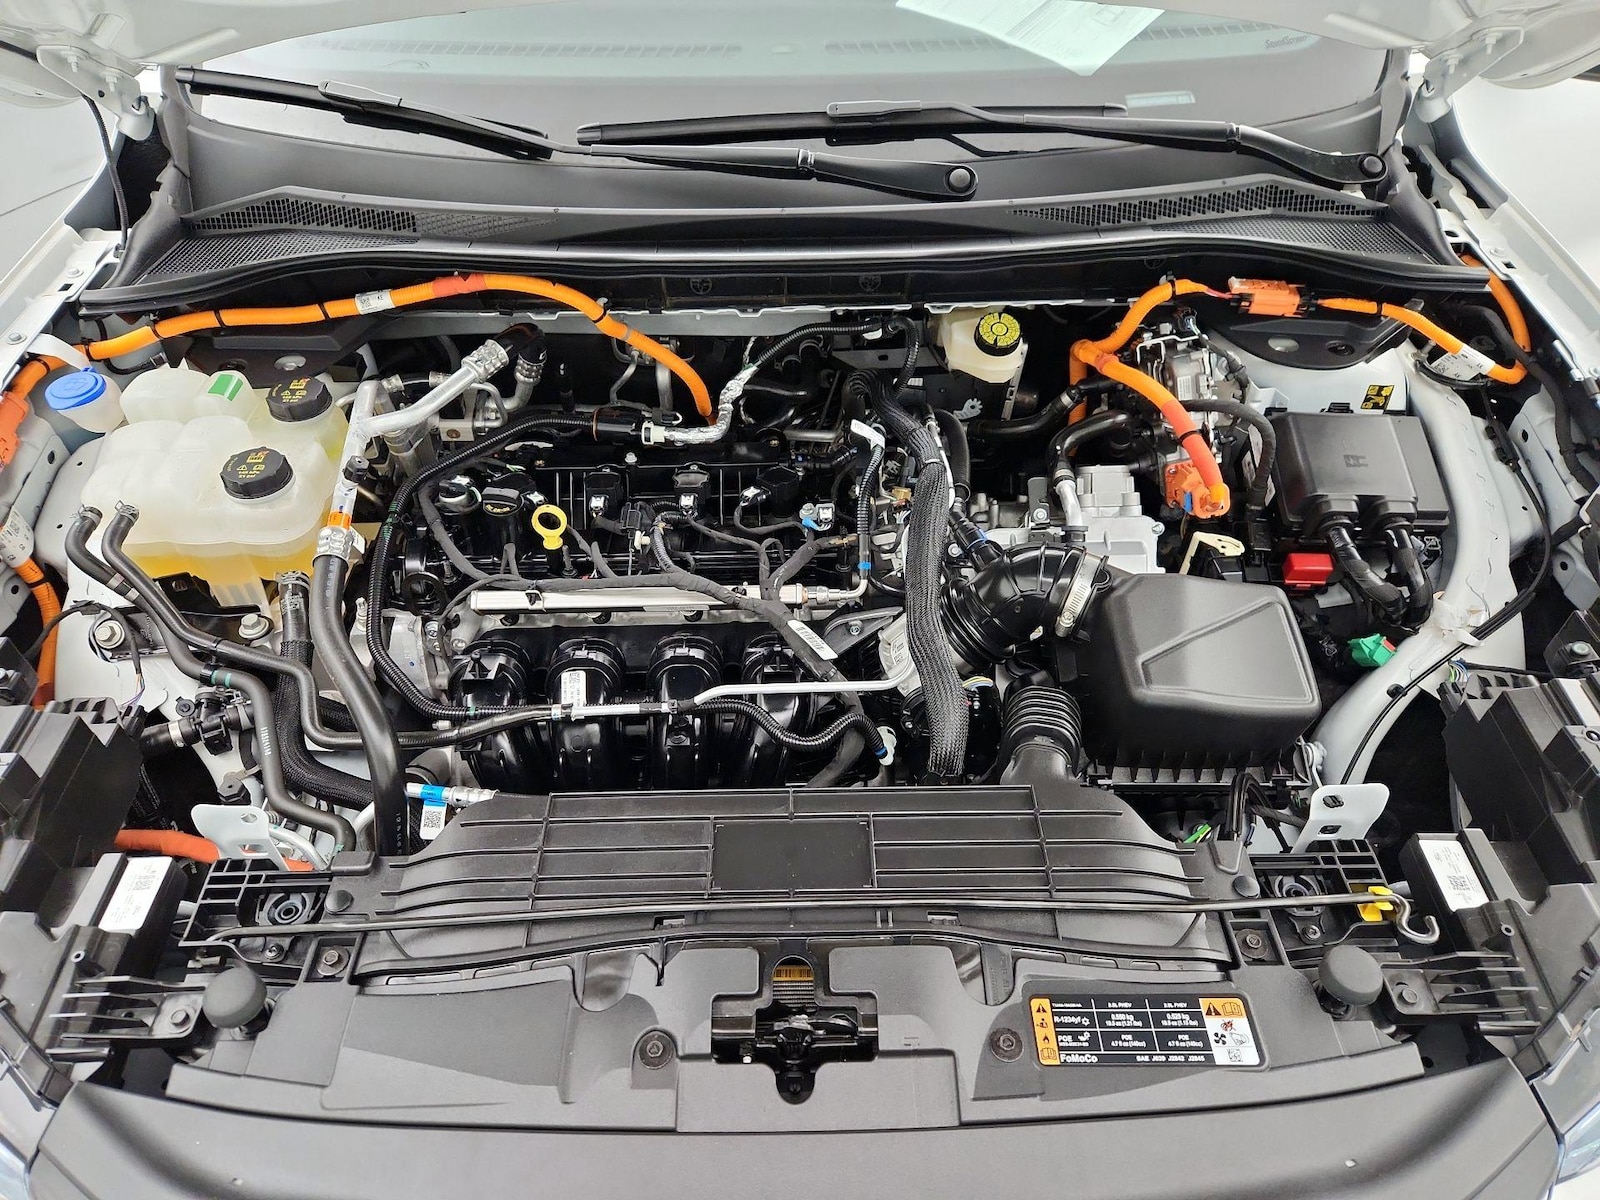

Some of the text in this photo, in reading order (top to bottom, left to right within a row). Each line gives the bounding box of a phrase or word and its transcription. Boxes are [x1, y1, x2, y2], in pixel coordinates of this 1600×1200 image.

[1054, 1015, 1081, 1024] R-1234yf
[1126, 1013, 1135, 1021] kg
[1181, 1013, 1190, 1021] kg
[1060, 1054, 1098, 1062] FoMoCo
